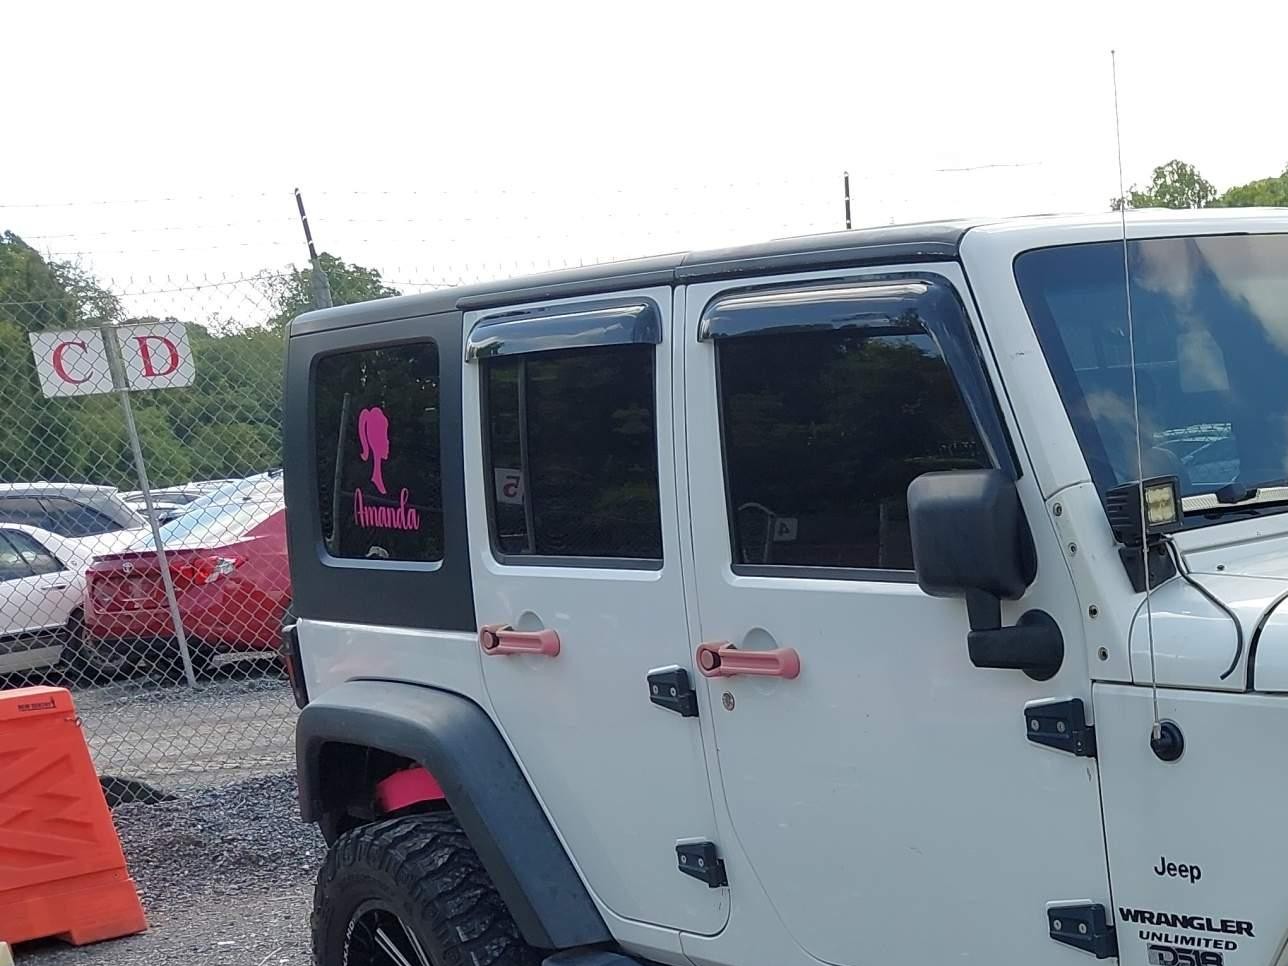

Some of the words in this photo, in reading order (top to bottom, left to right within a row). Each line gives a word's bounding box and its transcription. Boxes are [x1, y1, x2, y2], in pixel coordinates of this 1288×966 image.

[52, 341, 94, 384] C
[132, 335, 179, 377] D
[354, 487, 420, 531] Amanda
[1154, 856, 1202, 884] Jeep
[1118, 907, 1256, 938] WRANGLER
[1138, 930, 1238, 951] UNLIMITED
